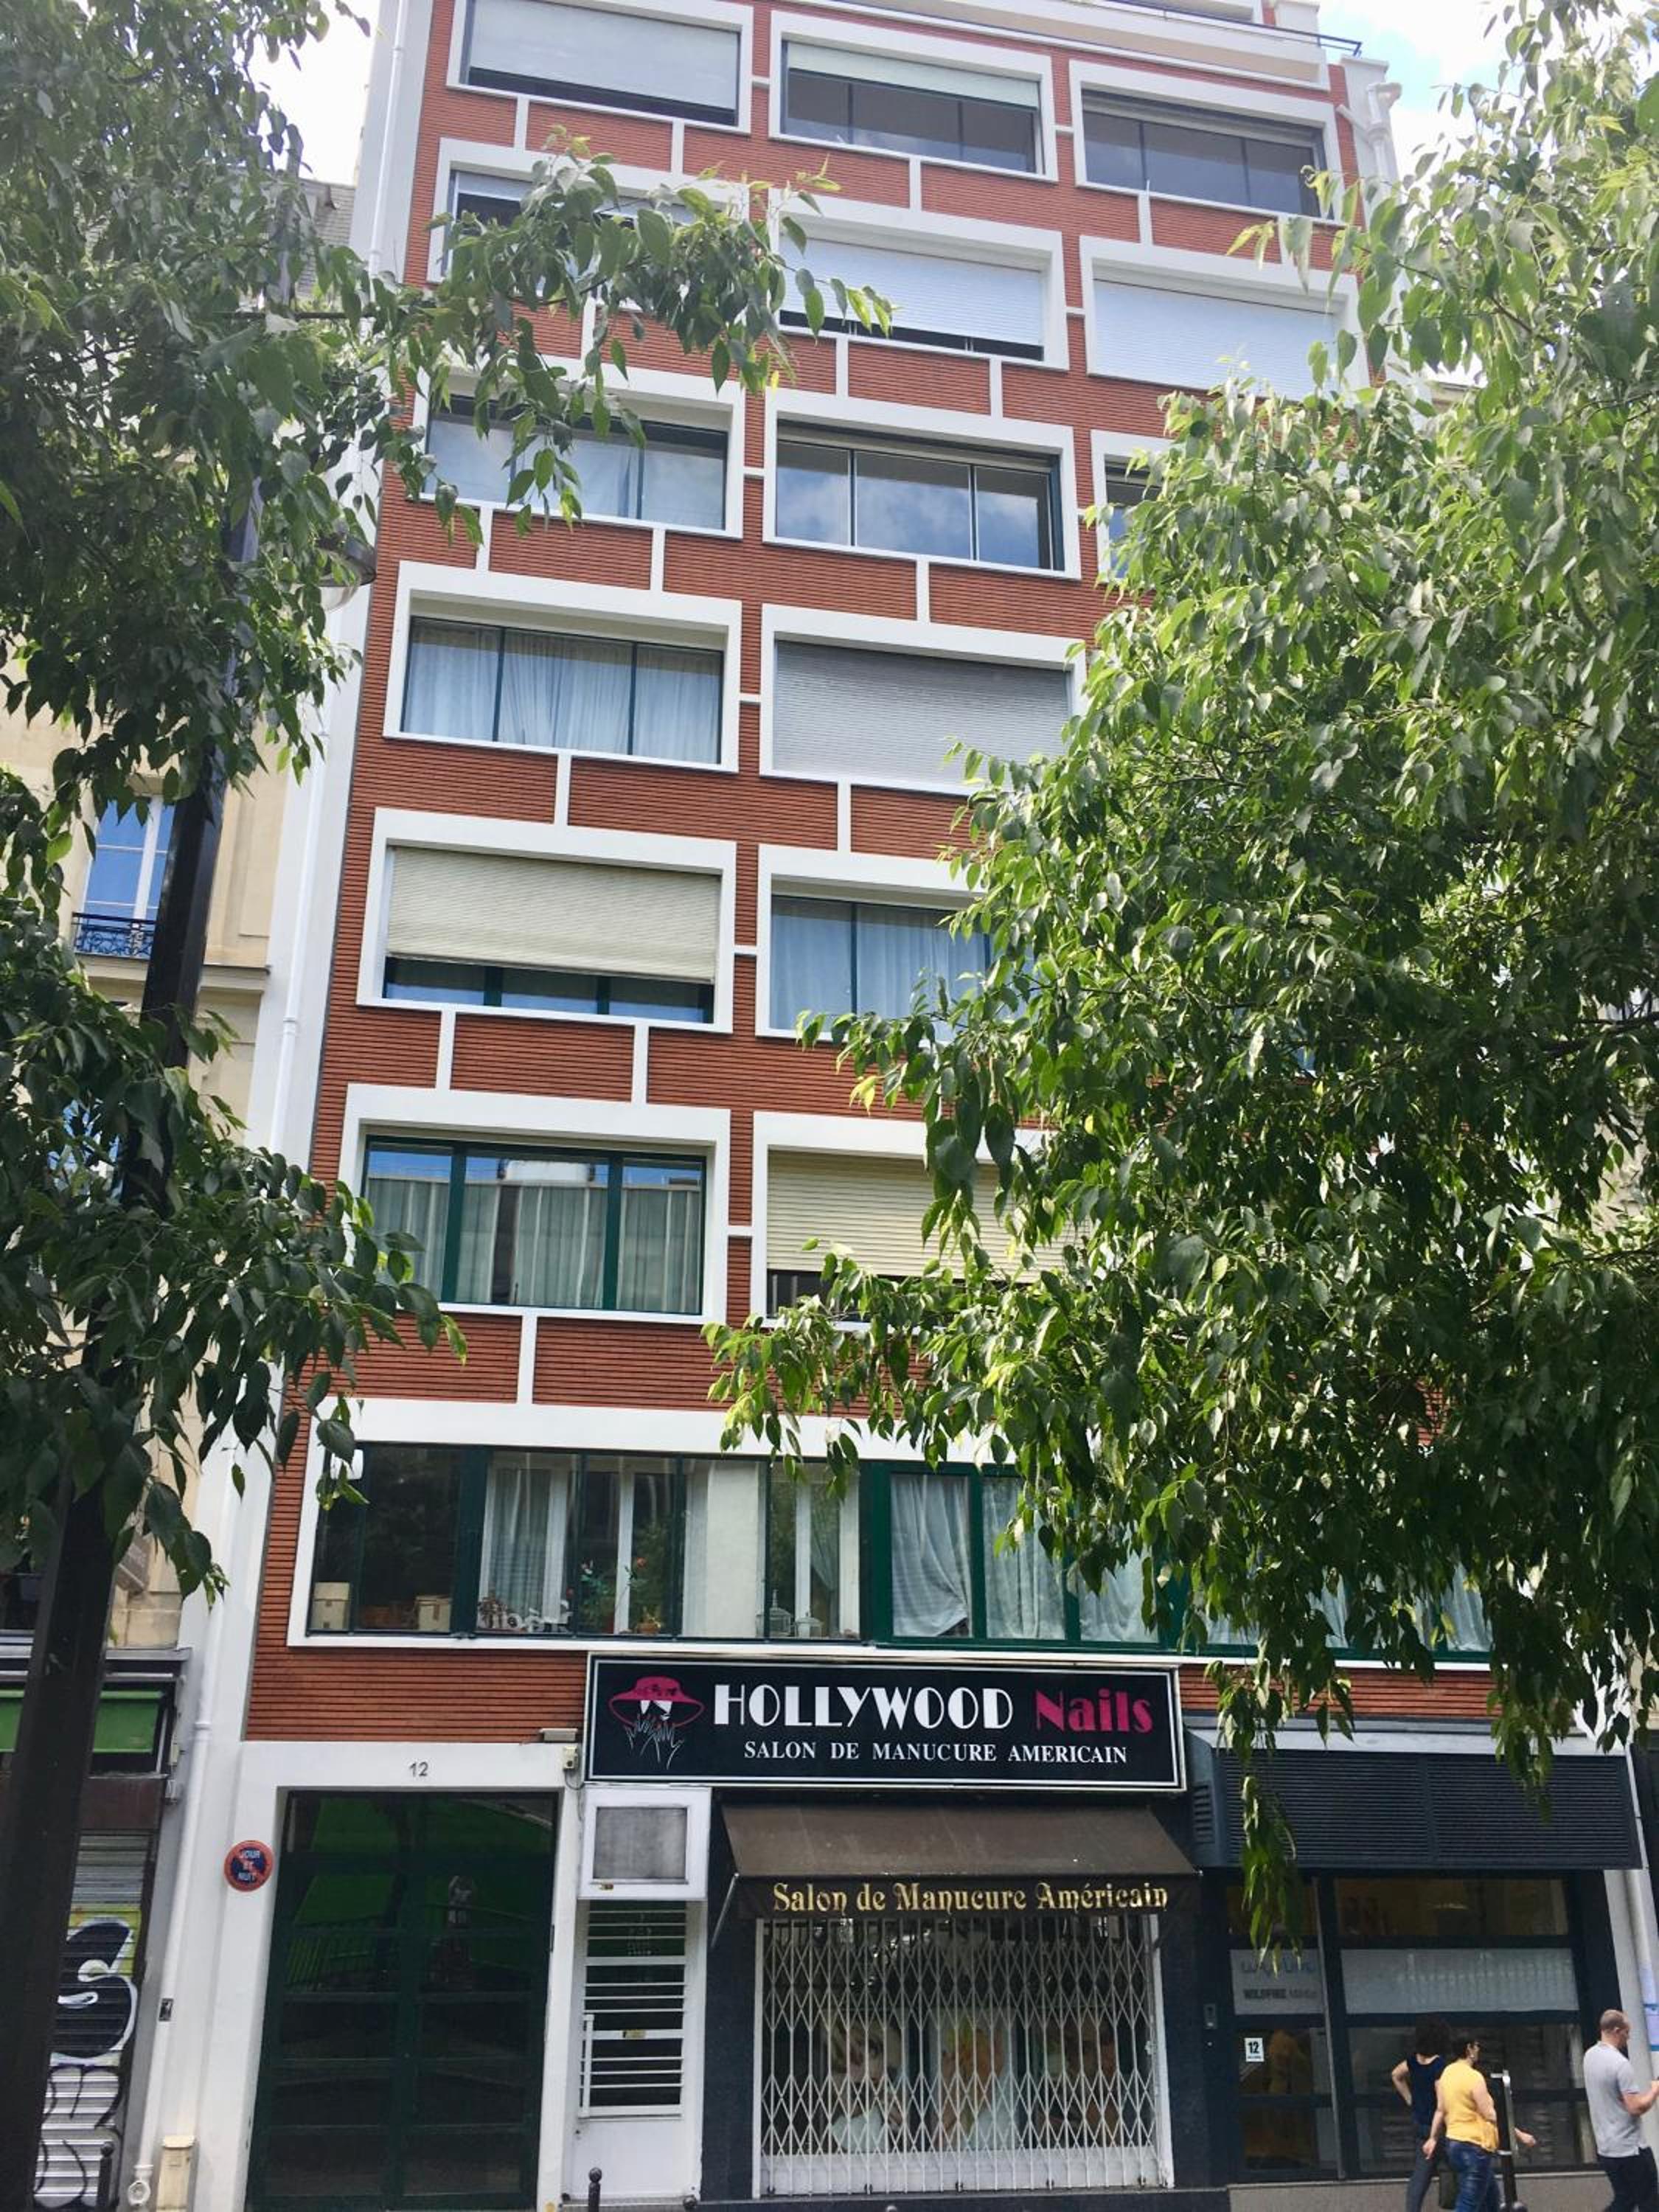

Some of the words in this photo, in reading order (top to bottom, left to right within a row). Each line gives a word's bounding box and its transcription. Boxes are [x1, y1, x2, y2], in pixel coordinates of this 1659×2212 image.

[714, 1683, 1014, 1731] HOLLYWOOD
[1034, 1688, 1154, 1733] Nails
[744, 1740, 816, 1759] SALON
[830, 1742, 860, 1760] DE
[872, 1742, 997, 1761] MANUCURE
[1007, 1745, 1127, 1764] AMERICAIN
[408, 1761, 429, 1778] 12
[773, 1882, 847, 1916] Salon
[856, 1882, 886, 1911] de
[892, 1882, 1027, 1915] Manucure
[1036, 1882, 1168, 1914] Américain
[1248, 2041, 1260, 2053] 12
